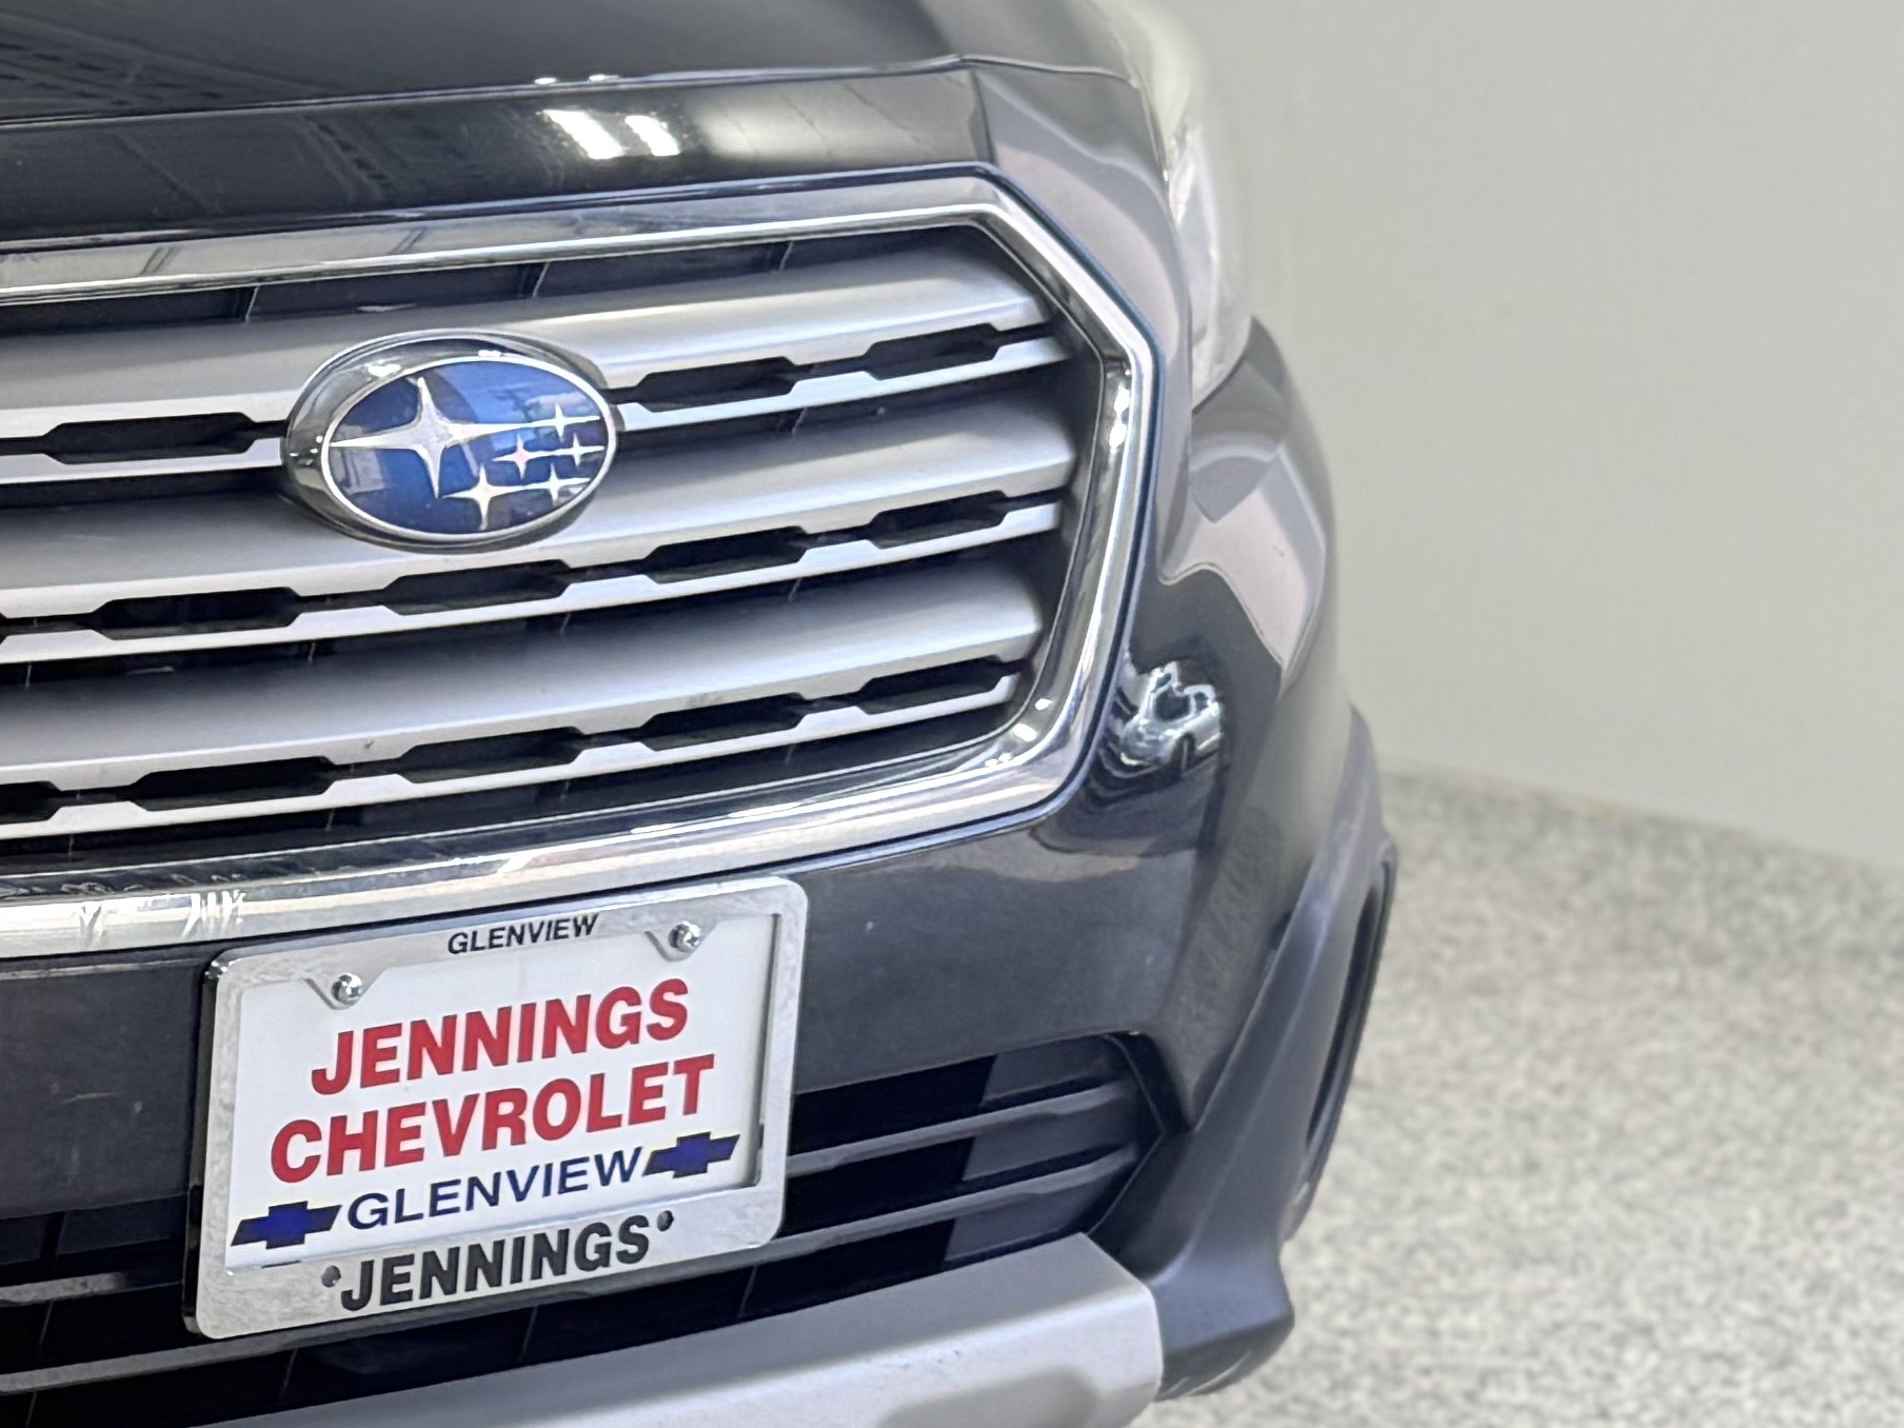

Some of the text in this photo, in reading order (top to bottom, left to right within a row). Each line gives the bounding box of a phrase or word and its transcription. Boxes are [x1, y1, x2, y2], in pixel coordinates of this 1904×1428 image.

[447, 913, 599, 955] GLENVIEW
[310, 978, 690, 1096] JENNINGS
[270, 1053, 715, 1183] CHEVROLET
[346, 1145, 644, 1231] GLENVIEW
[340, 1214, 650, 1312] JENNINGS
